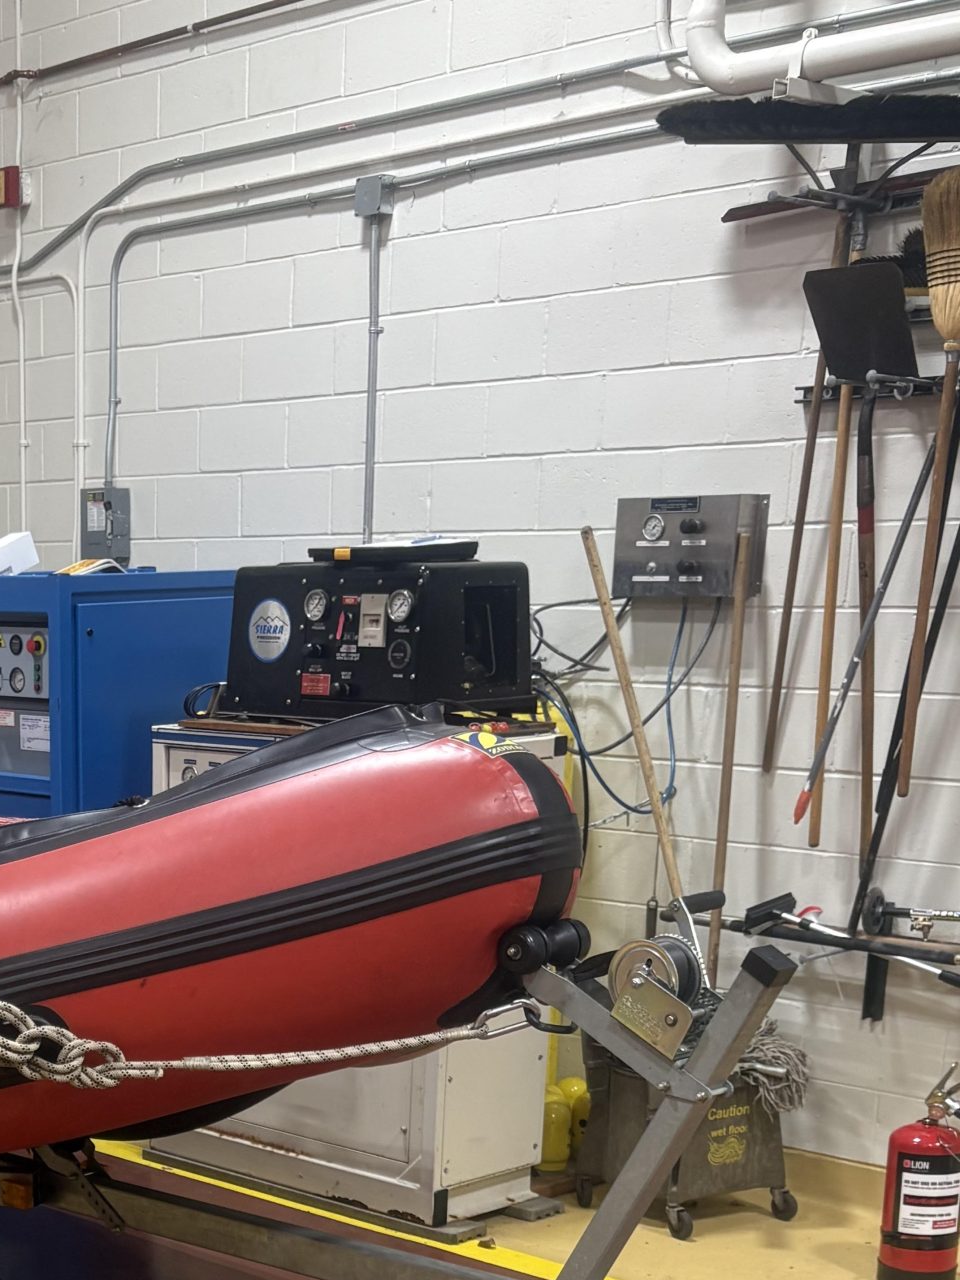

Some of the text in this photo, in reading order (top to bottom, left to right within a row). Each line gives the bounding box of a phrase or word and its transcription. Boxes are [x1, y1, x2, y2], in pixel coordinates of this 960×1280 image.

[255, 623, 284, 635] SIERRA
[707, 1104, 751, 1120] Caution
[710, 1127, 727, 1138] wet
[911, 1160, 930, 1170] LION
